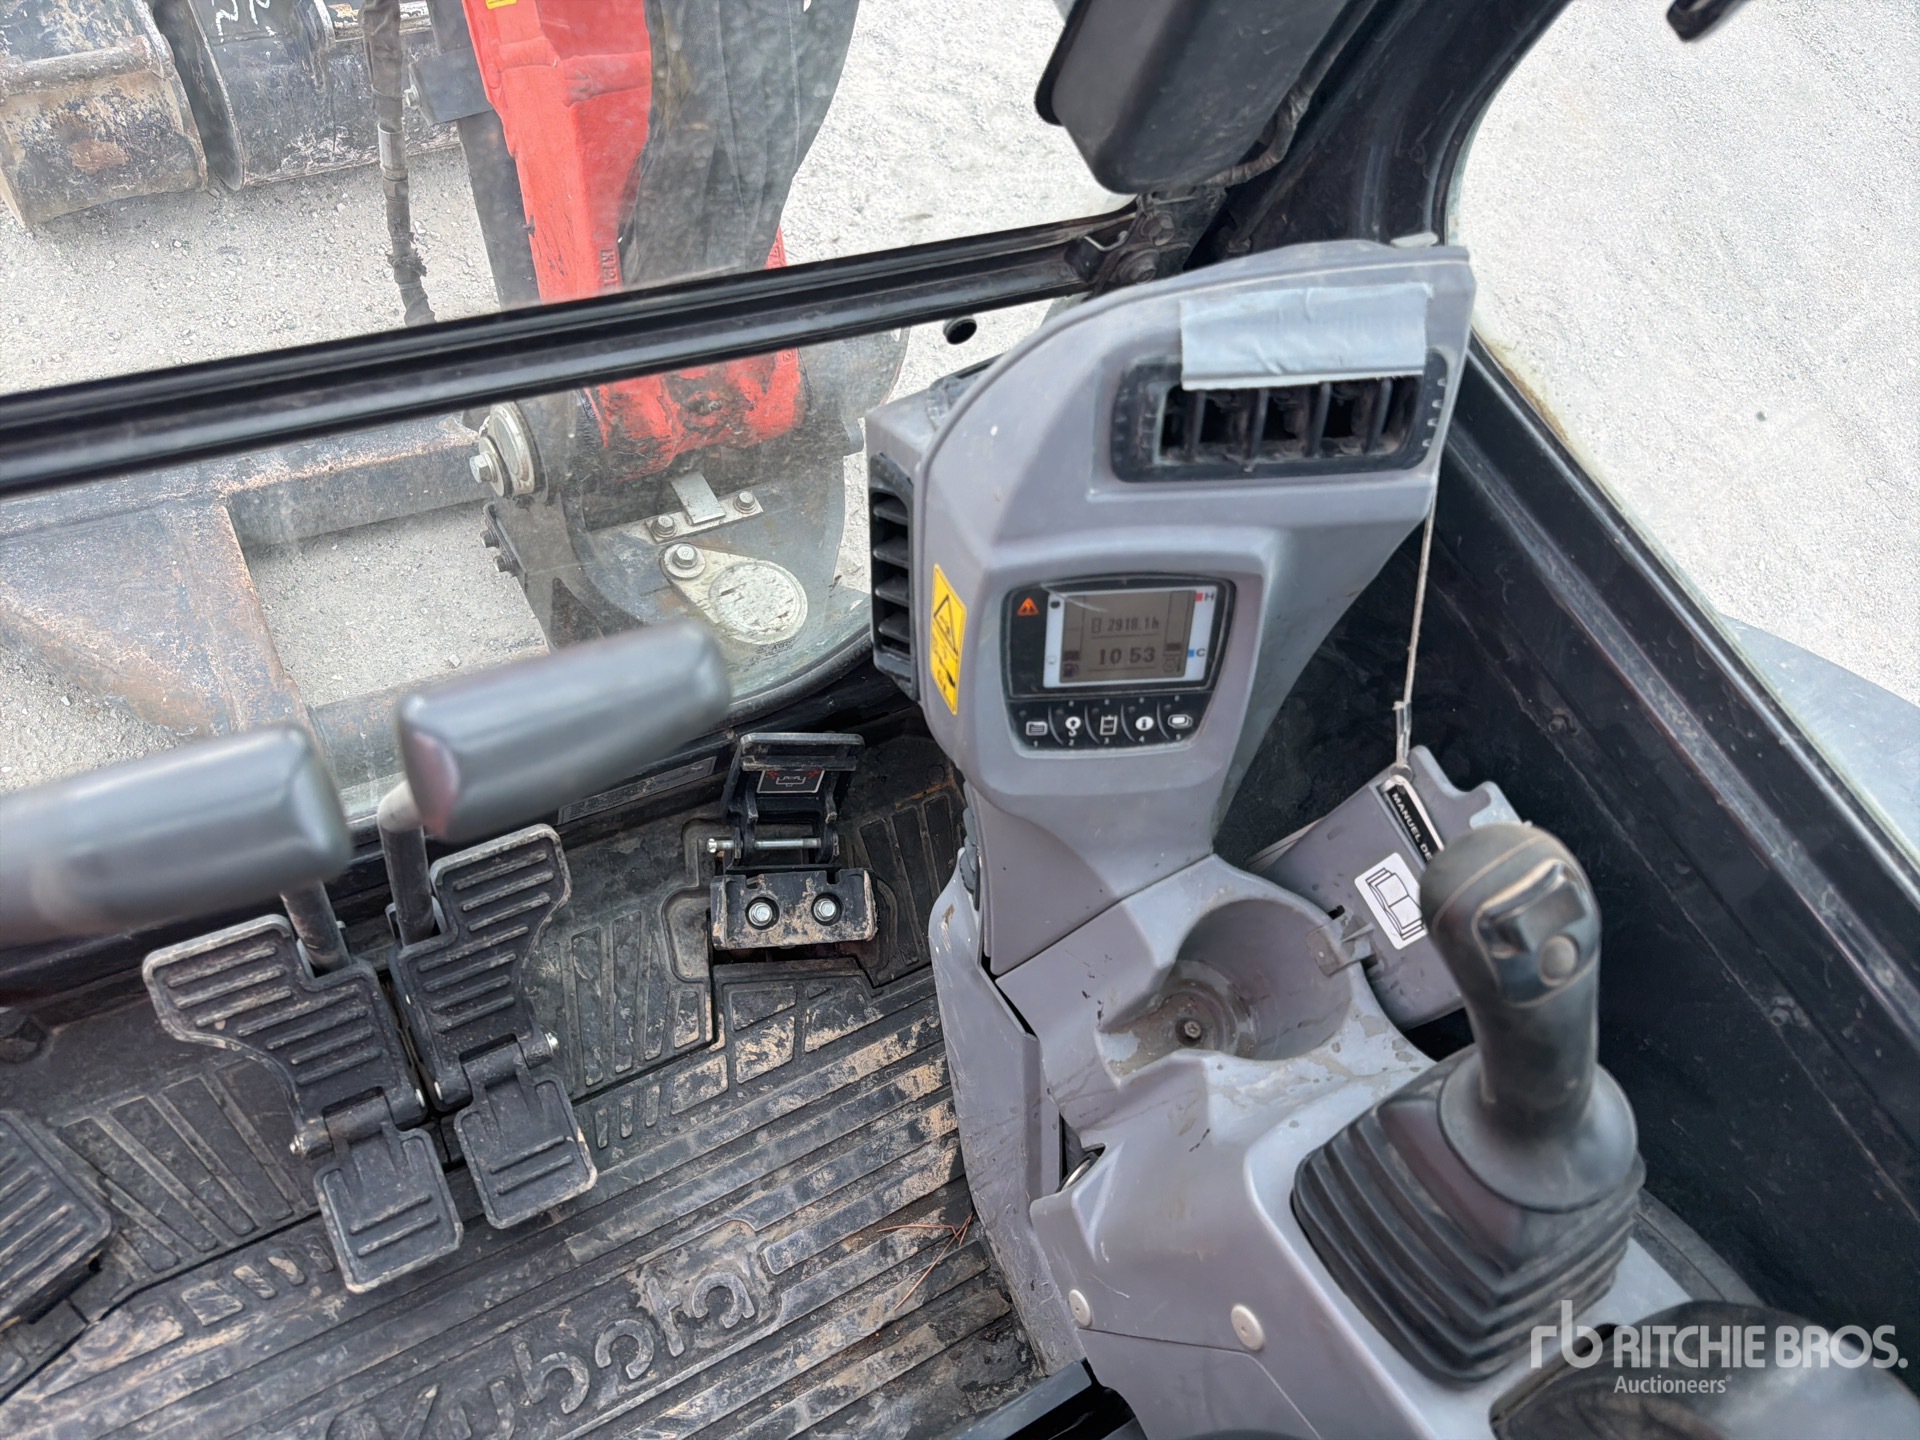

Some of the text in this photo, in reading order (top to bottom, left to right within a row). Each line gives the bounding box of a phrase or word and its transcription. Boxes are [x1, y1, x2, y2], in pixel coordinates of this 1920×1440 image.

[1204, 592, 1215, 601] H
[1196, 648, 1206, 657] C
[1392, 793, 1421, 842] MANUEL
